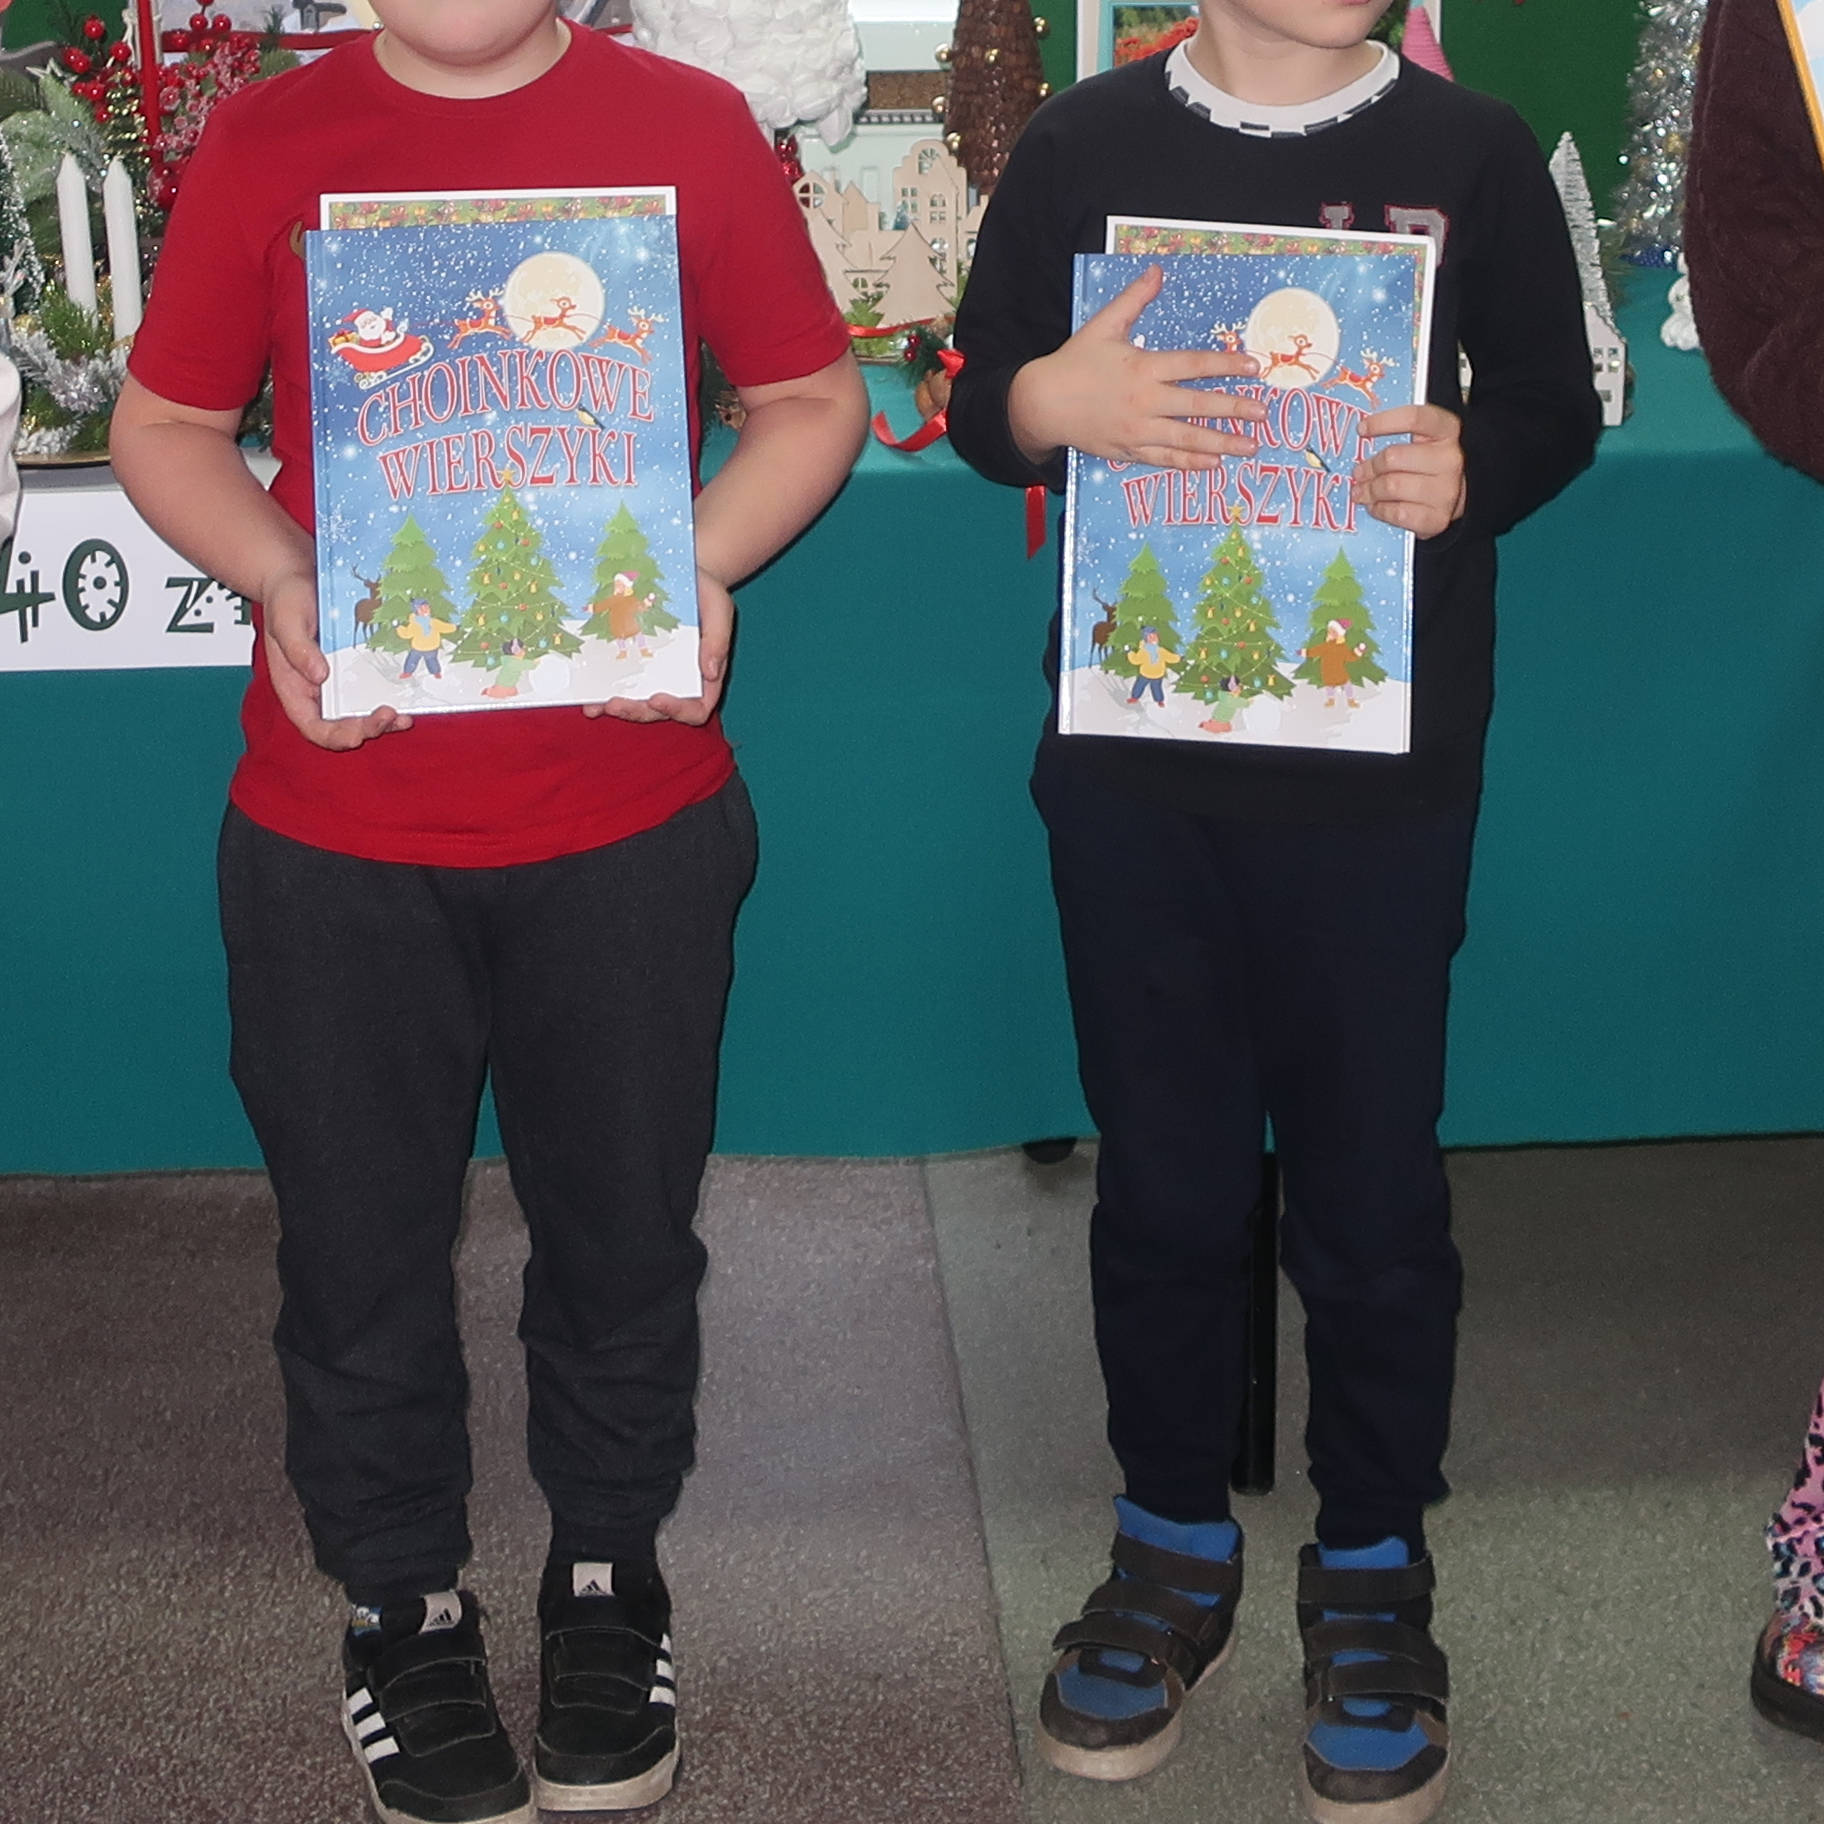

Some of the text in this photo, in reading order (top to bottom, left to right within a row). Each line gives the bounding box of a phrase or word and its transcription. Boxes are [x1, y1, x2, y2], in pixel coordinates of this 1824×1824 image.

[356, 347, 655, 448] CHOINKOWE
[377, 425, 637, 502] WIERSZYKI
[1120, 461, 1358, 533] WIERSZYKI
